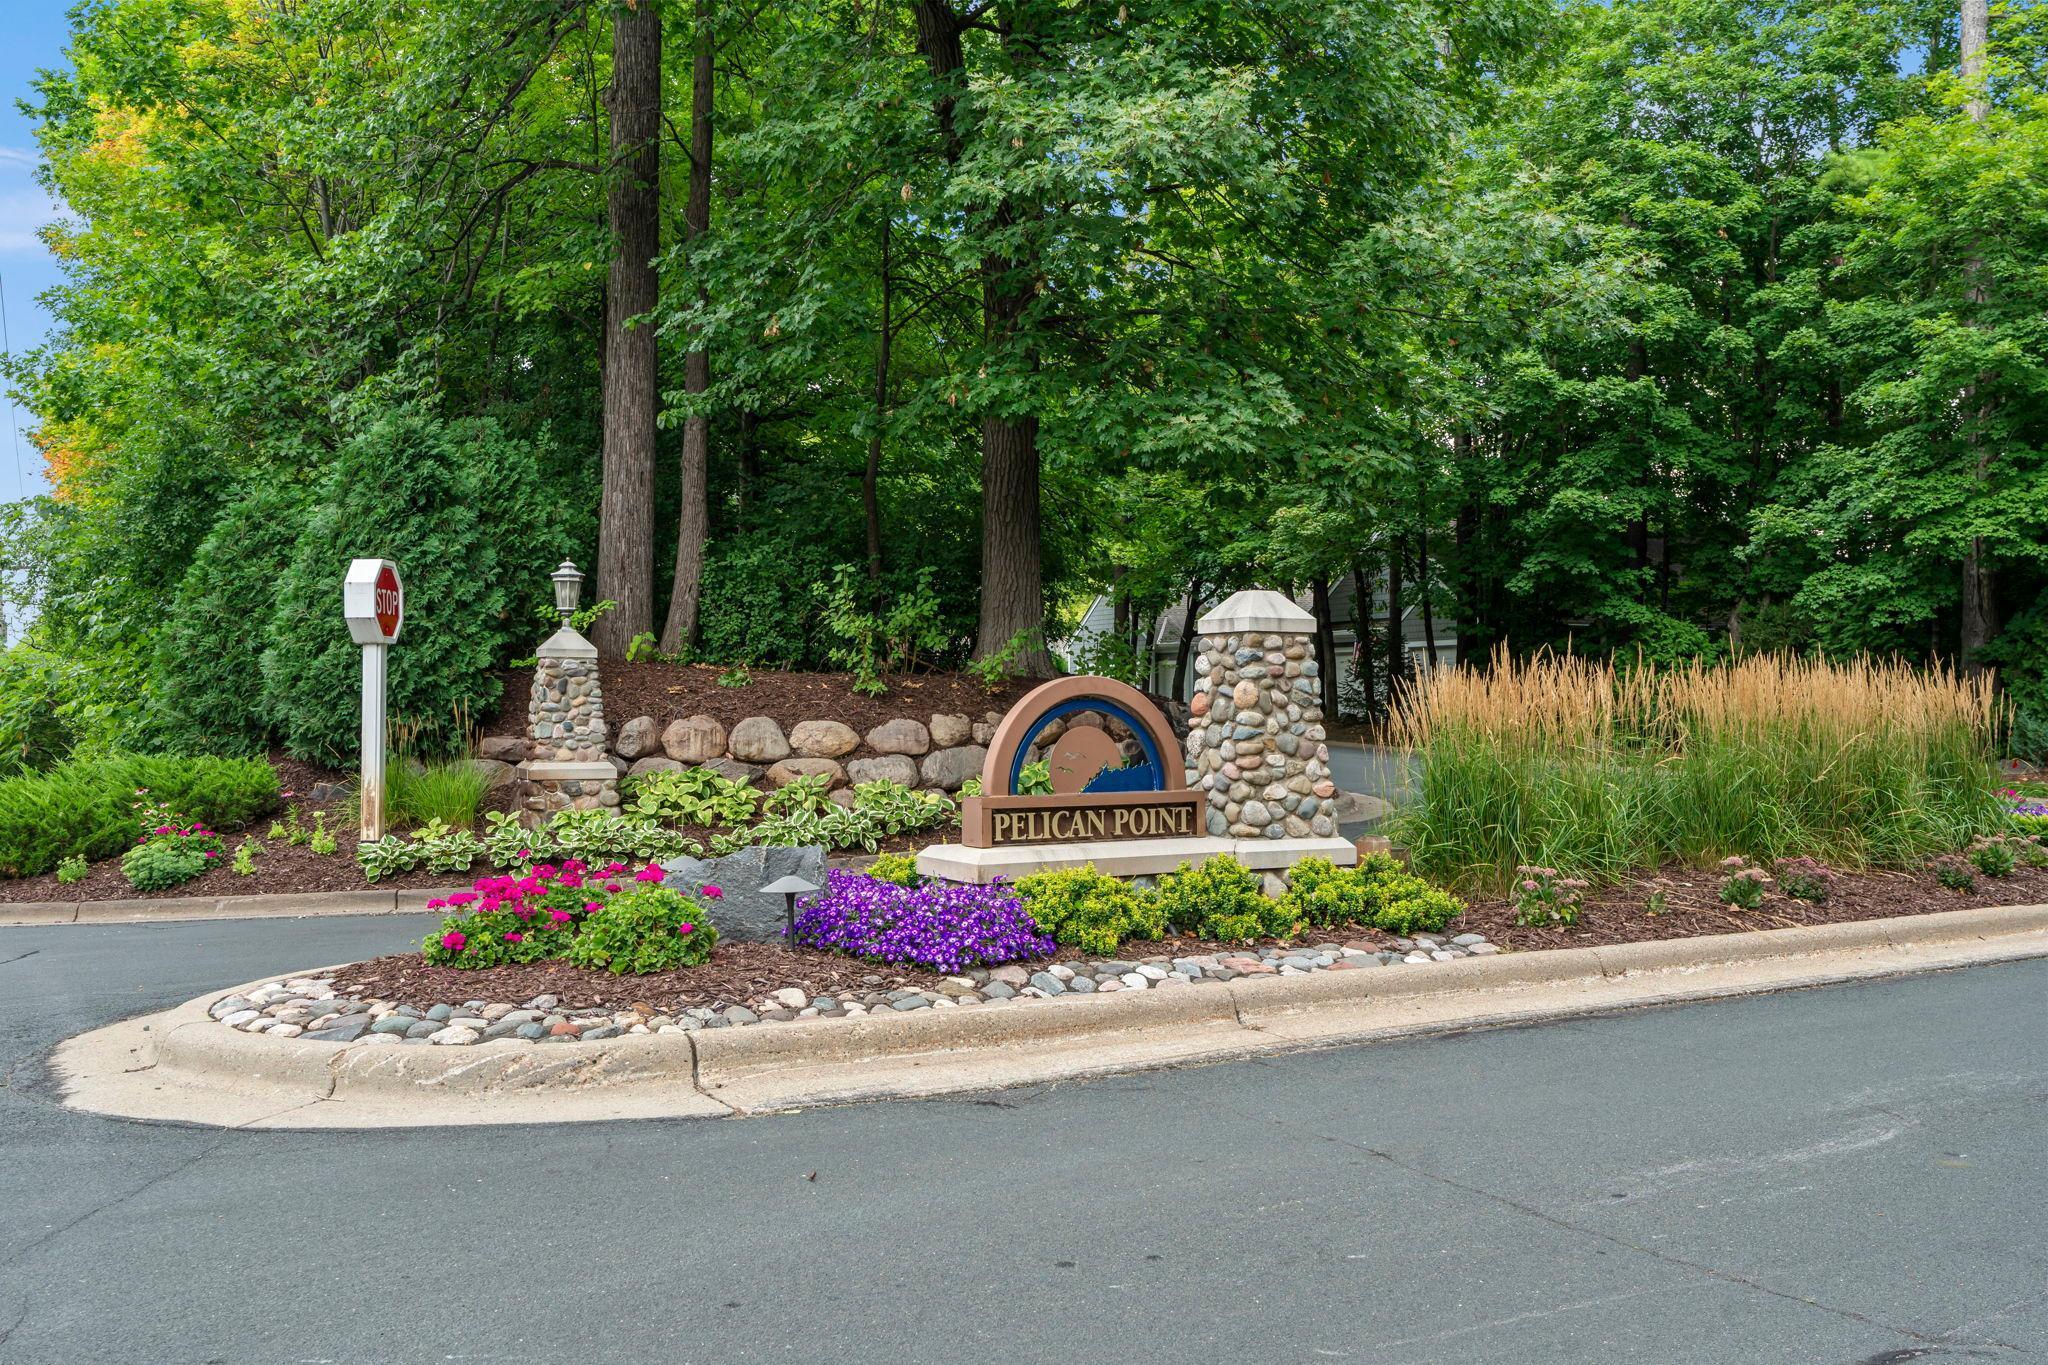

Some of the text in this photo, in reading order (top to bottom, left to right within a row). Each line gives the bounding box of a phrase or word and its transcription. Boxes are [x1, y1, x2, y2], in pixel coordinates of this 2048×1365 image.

[376, 588, 398, 615] STOP
[993, 806, 1192, 841] PELICAN POINT
